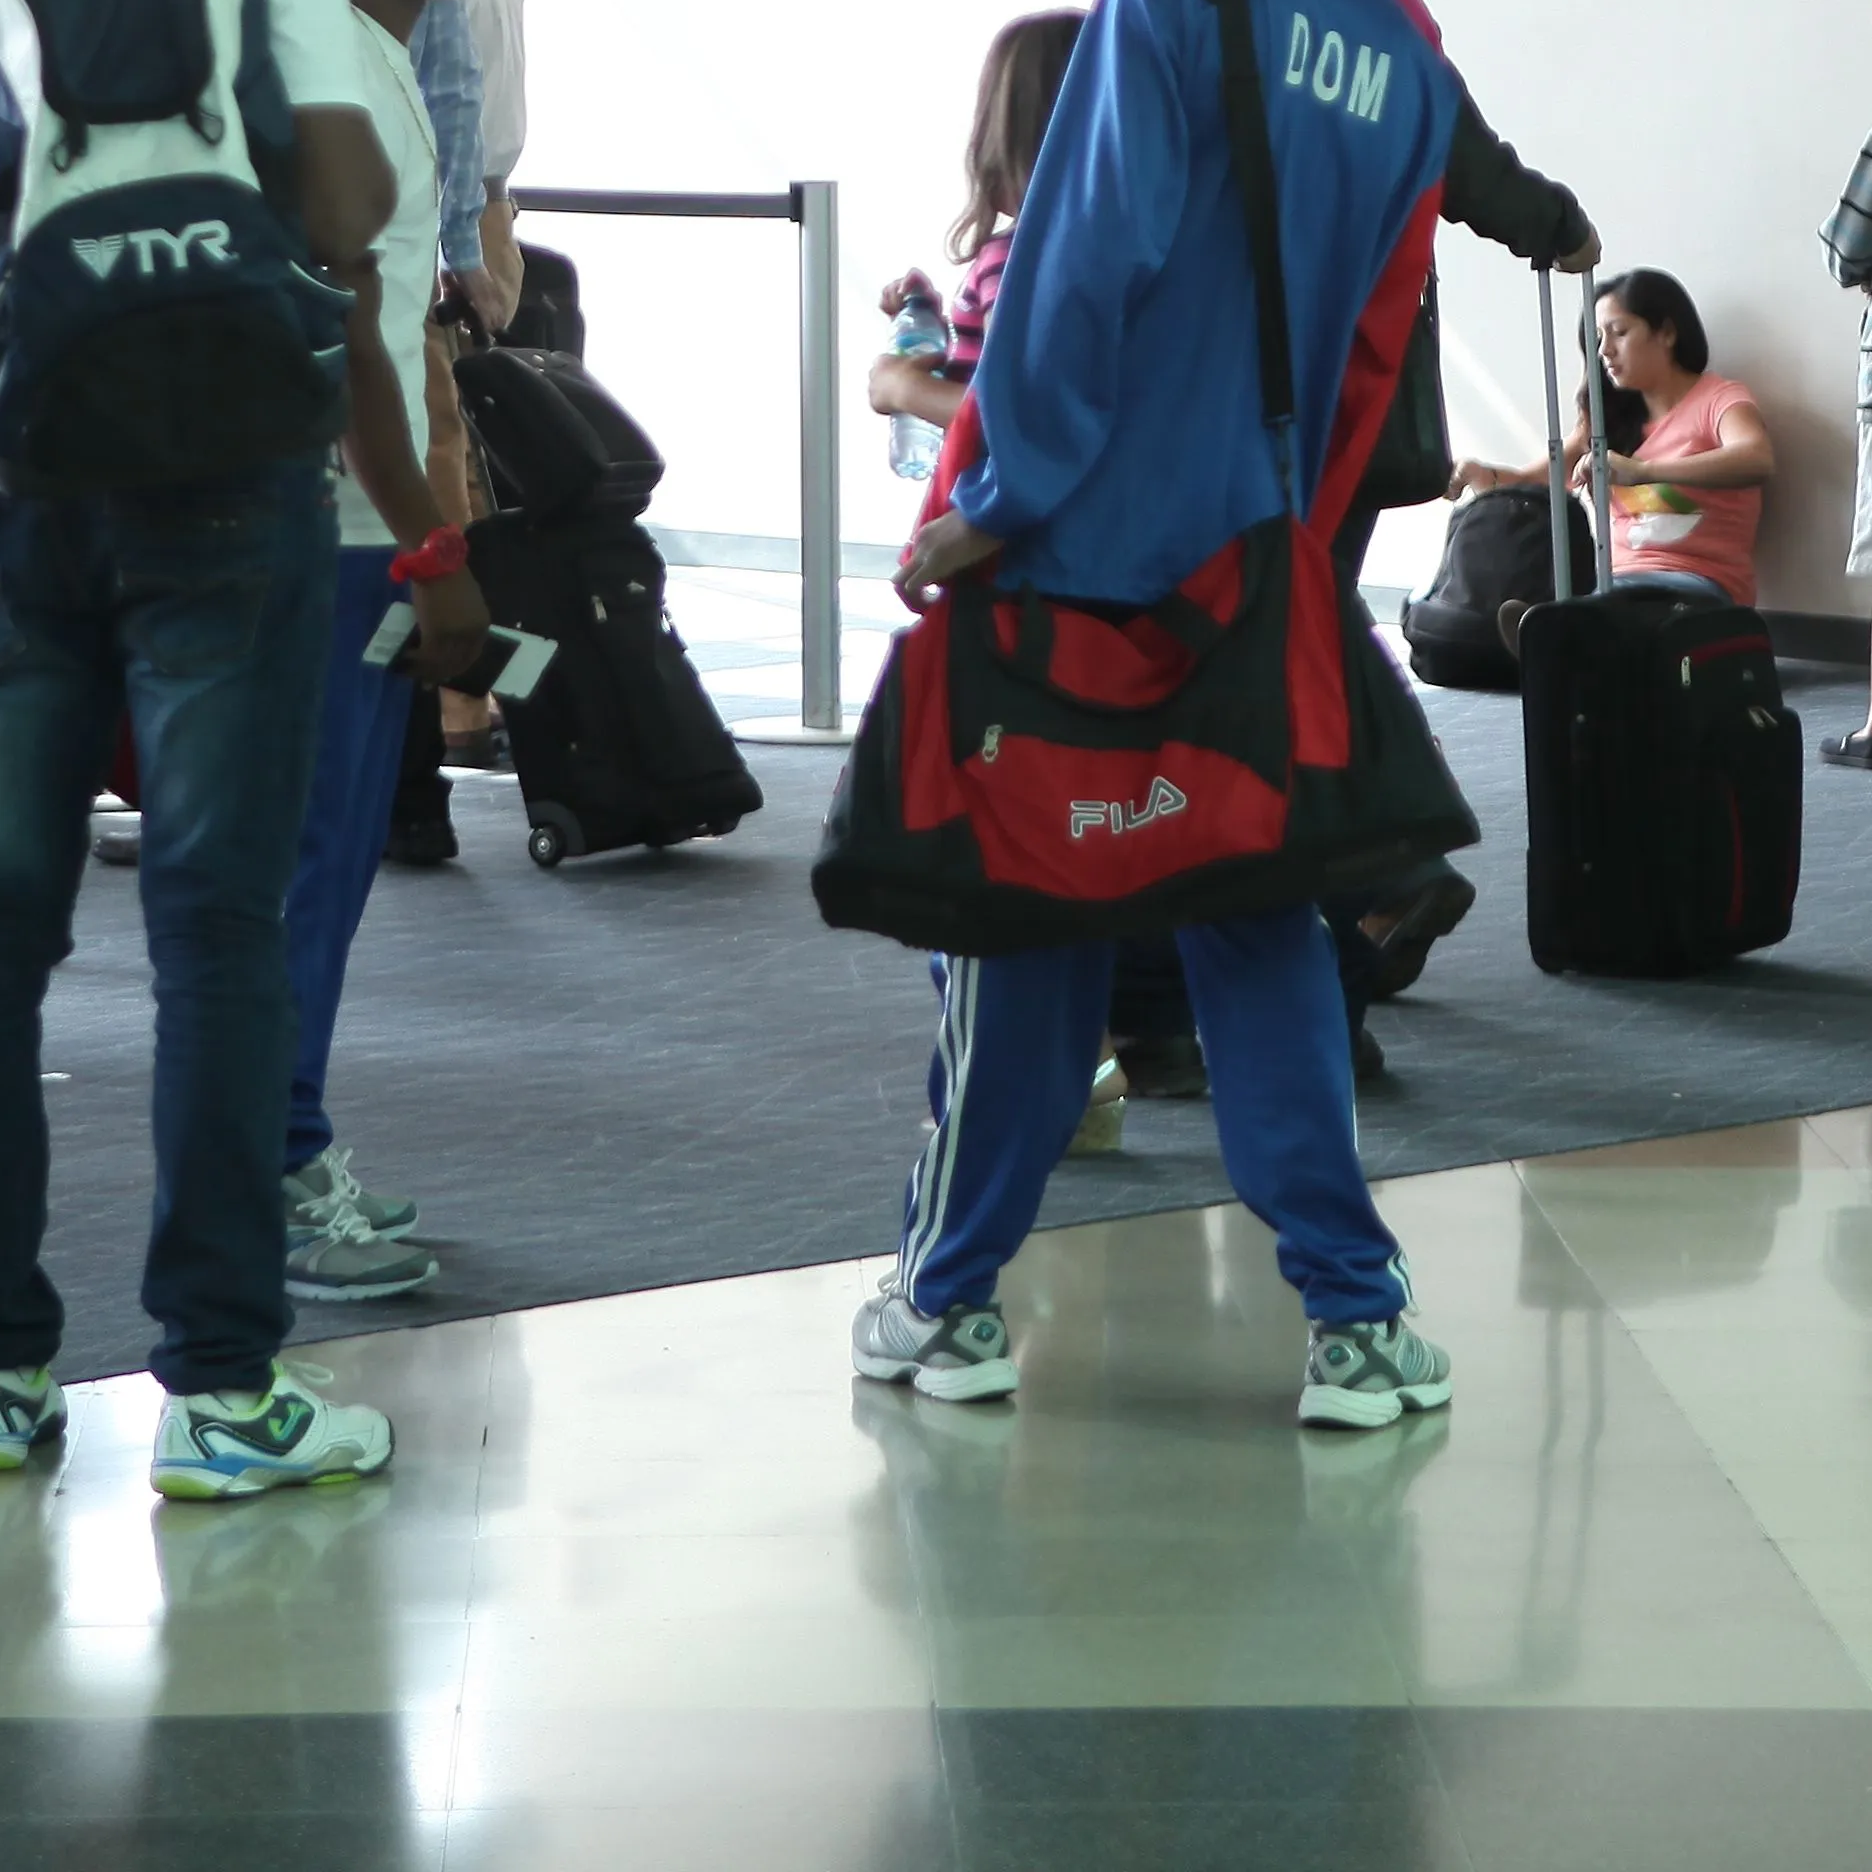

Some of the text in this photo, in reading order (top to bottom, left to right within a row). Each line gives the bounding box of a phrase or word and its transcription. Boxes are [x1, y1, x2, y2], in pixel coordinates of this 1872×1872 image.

[1286, 11, 1391, 122] DOM
[127, 219, 232, 273] TYR
[1070, 775, 1187, 838] FILA
